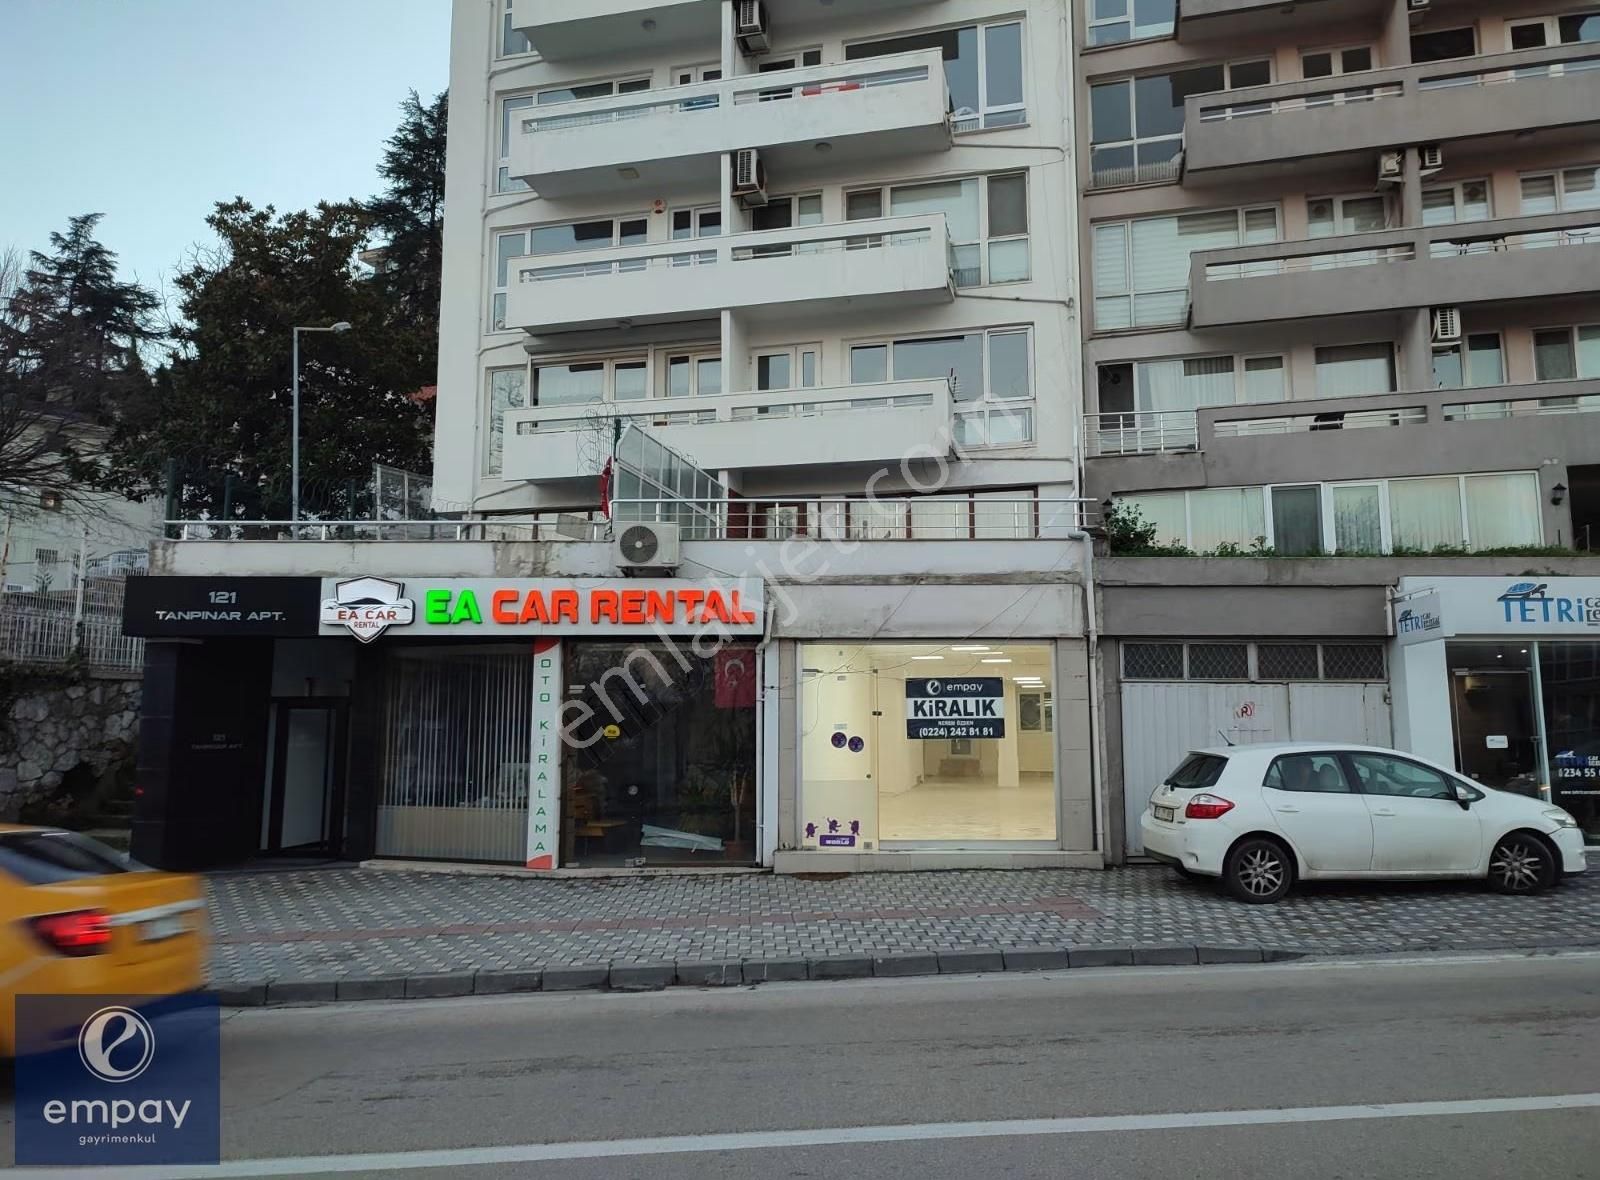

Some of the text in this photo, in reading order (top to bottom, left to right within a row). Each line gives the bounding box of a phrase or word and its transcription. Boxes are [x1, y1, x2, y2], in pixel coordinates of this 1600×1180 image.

[208, 590, 237, 604] 121
[426, 589, 757, 625] EA CAR RENTAL
[156, 610, 286, 622] TANPINAR APT.
[337, 610, 397, 620] EA CAR
[353, 621, 380, 629] RENTAL
[540, 659, 551, 702] OTO
[946, 683, 983, 692] empay
[919, 727, 993, 737] (0224) 242 81 81
